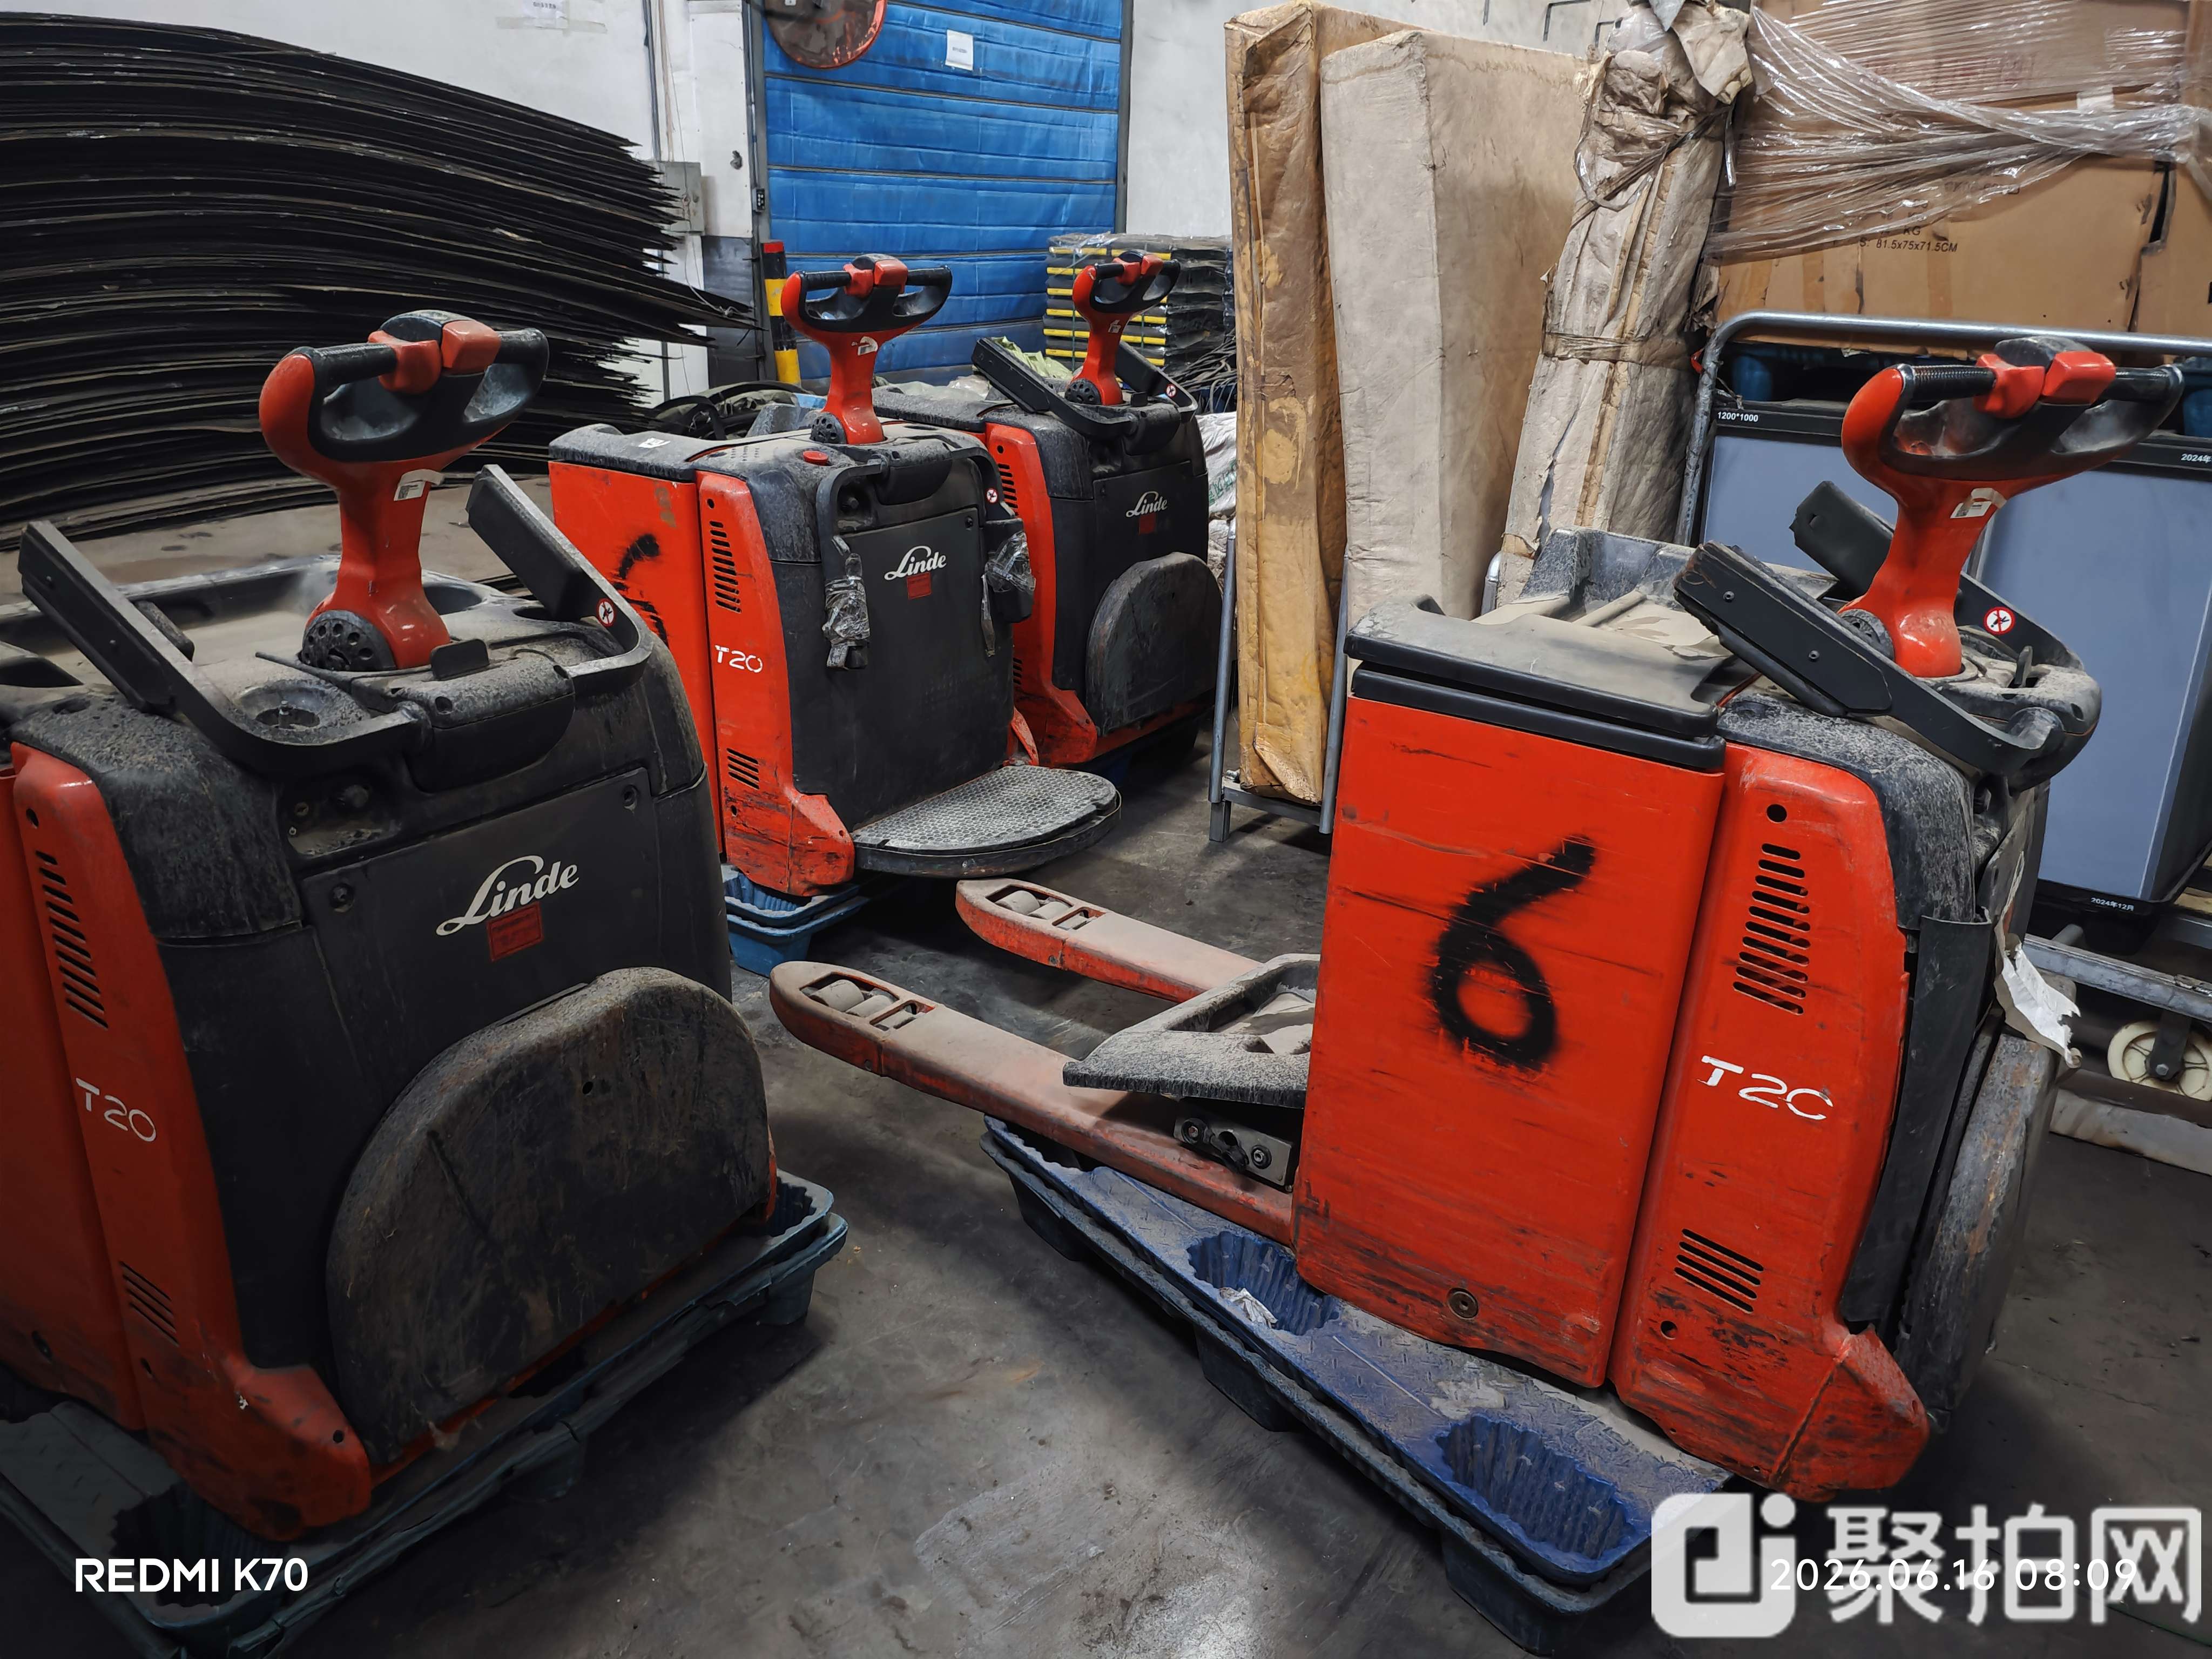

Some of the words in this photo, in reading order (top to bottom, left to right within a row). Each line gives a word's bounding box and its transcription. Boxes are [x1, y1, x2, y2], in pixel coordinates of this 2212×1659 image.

[1876, 239, 1958, 253] 81.5x75x71.5CM
[1125, 490, 1168, 518] Linde
[884, 545, 947, 581] Linde
[714, 644, 763, 673] T20
[435, 855, 579, 936] Linde
[2090, 897, 2135, 912] 2024年12月
[1427, 833, 1597, 1074] 6
[75, 1077, 157, 1142] T20
